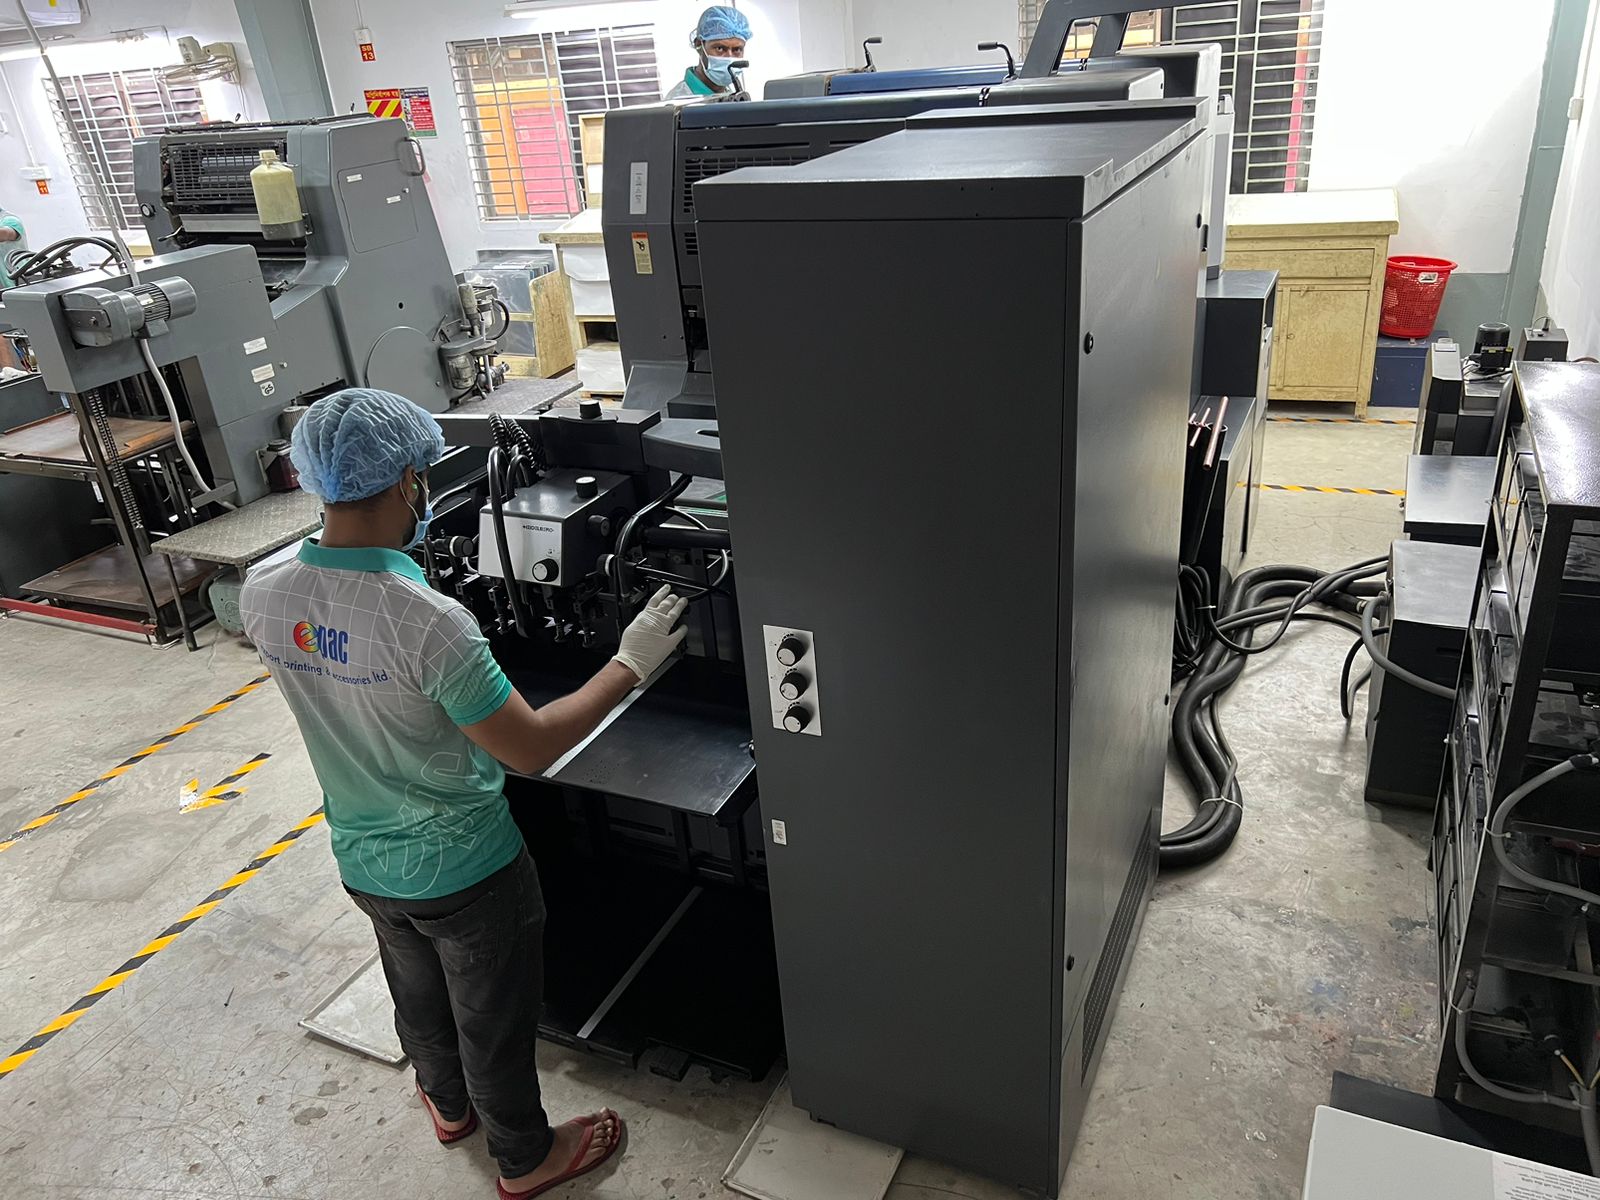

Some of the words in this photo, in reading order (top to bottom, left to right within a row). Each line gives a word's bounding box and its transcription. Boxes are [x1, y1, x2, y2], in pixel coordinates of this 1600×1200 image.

[363, 52, 374, 60] 13
[294, 620, 349, 664] epac
[284, 661, 322, 676] printing
[372, 670, 392, 683] ltd.
